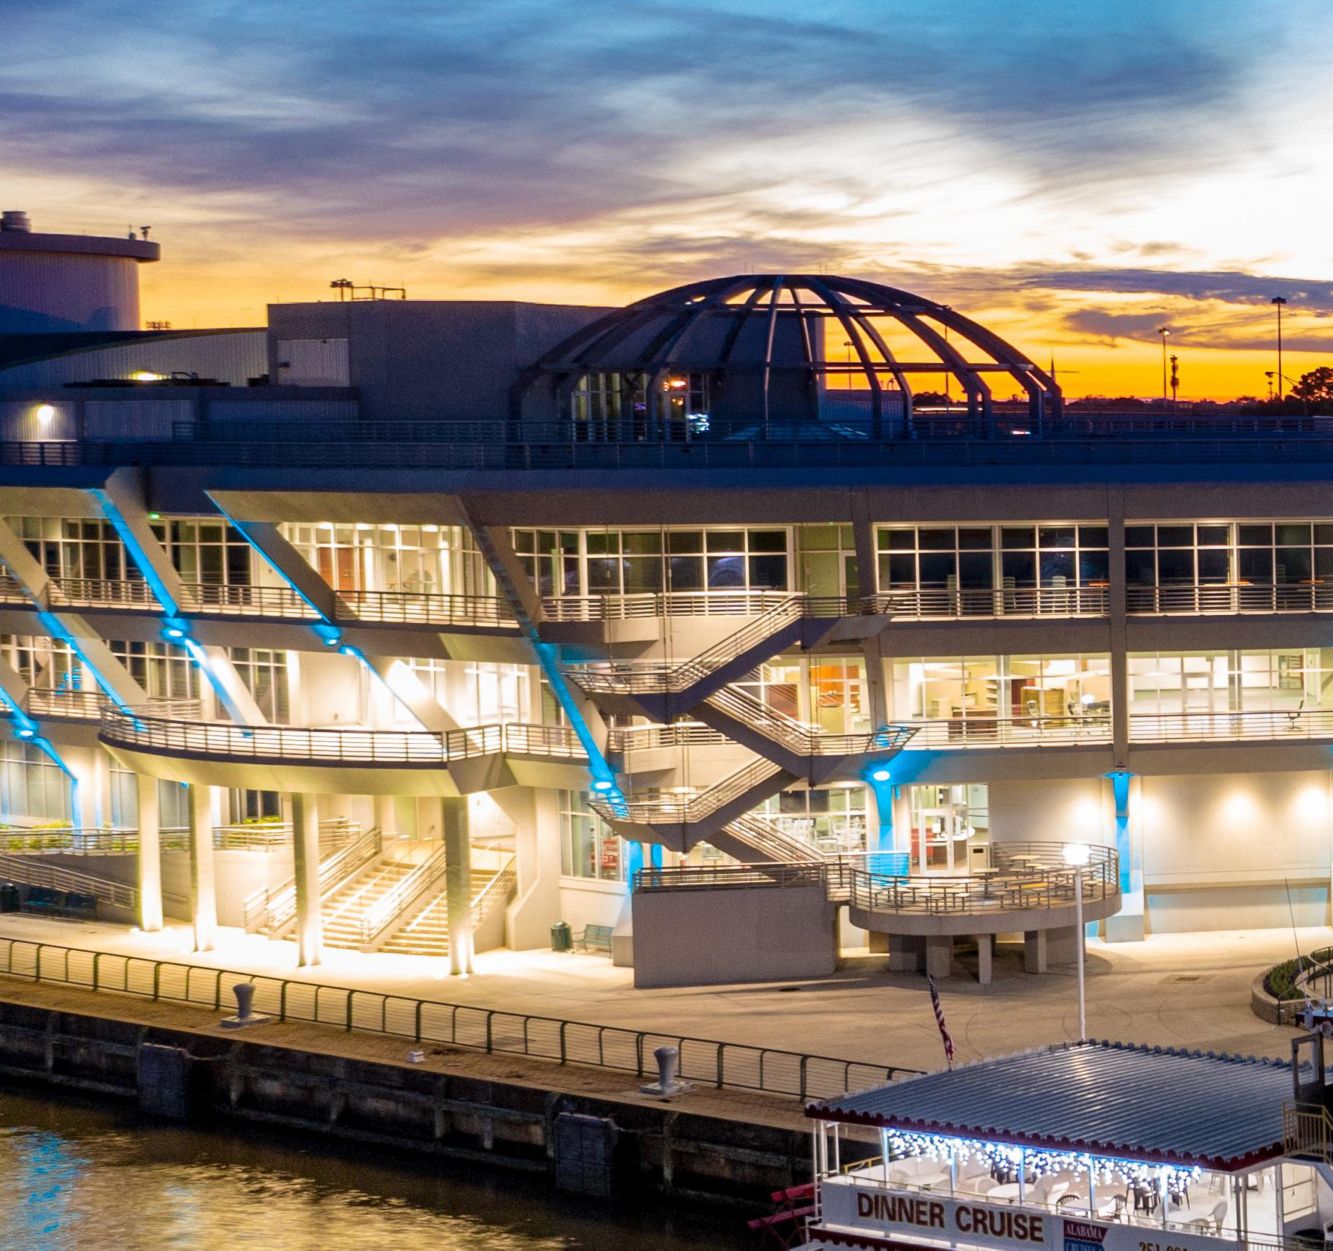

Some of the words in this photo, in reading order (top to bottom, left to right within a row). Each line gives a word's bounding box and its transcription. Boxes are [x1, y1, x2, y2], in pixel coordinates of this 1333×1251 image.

[857, 1192, 945, 1229] DINNER
[955, 1205, 1044, 1242] CRUISE
[1065, 1223, 1103, 1240] ALABAMA
